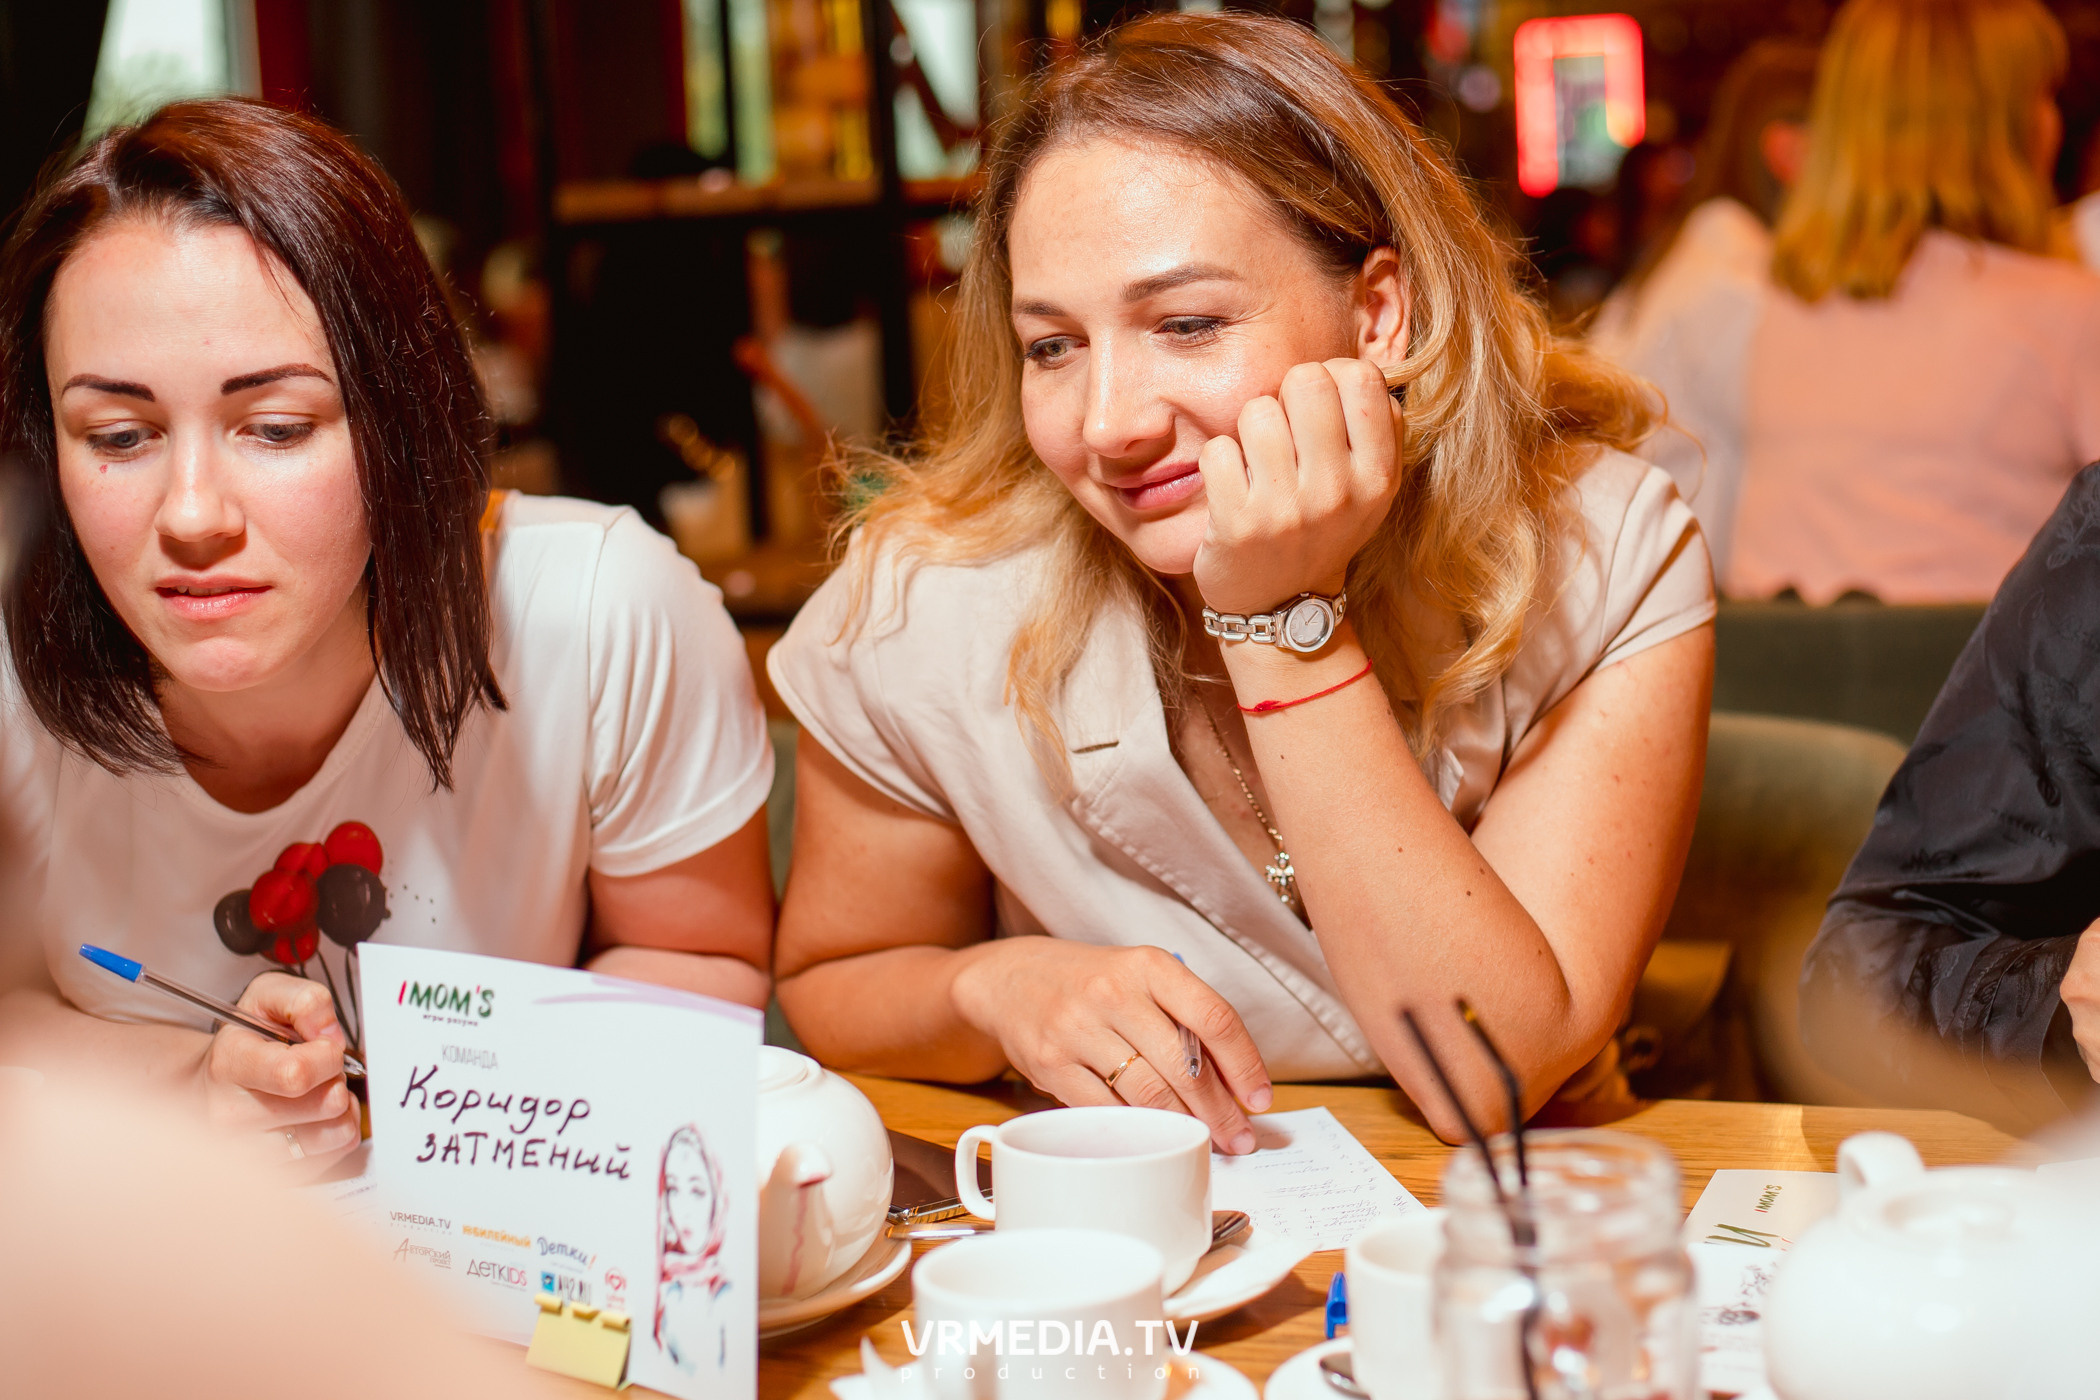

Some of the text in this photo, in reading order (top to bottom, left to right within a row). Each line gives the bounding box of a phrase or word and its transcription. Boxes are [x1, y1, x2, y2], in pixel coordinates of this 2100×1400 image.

[441, 1044, 498, 1069] КОМАНДА
[400, 1064, 591, 1135] Коридор
[389, 1210, 452, 1230] VRMEDIA.TV
